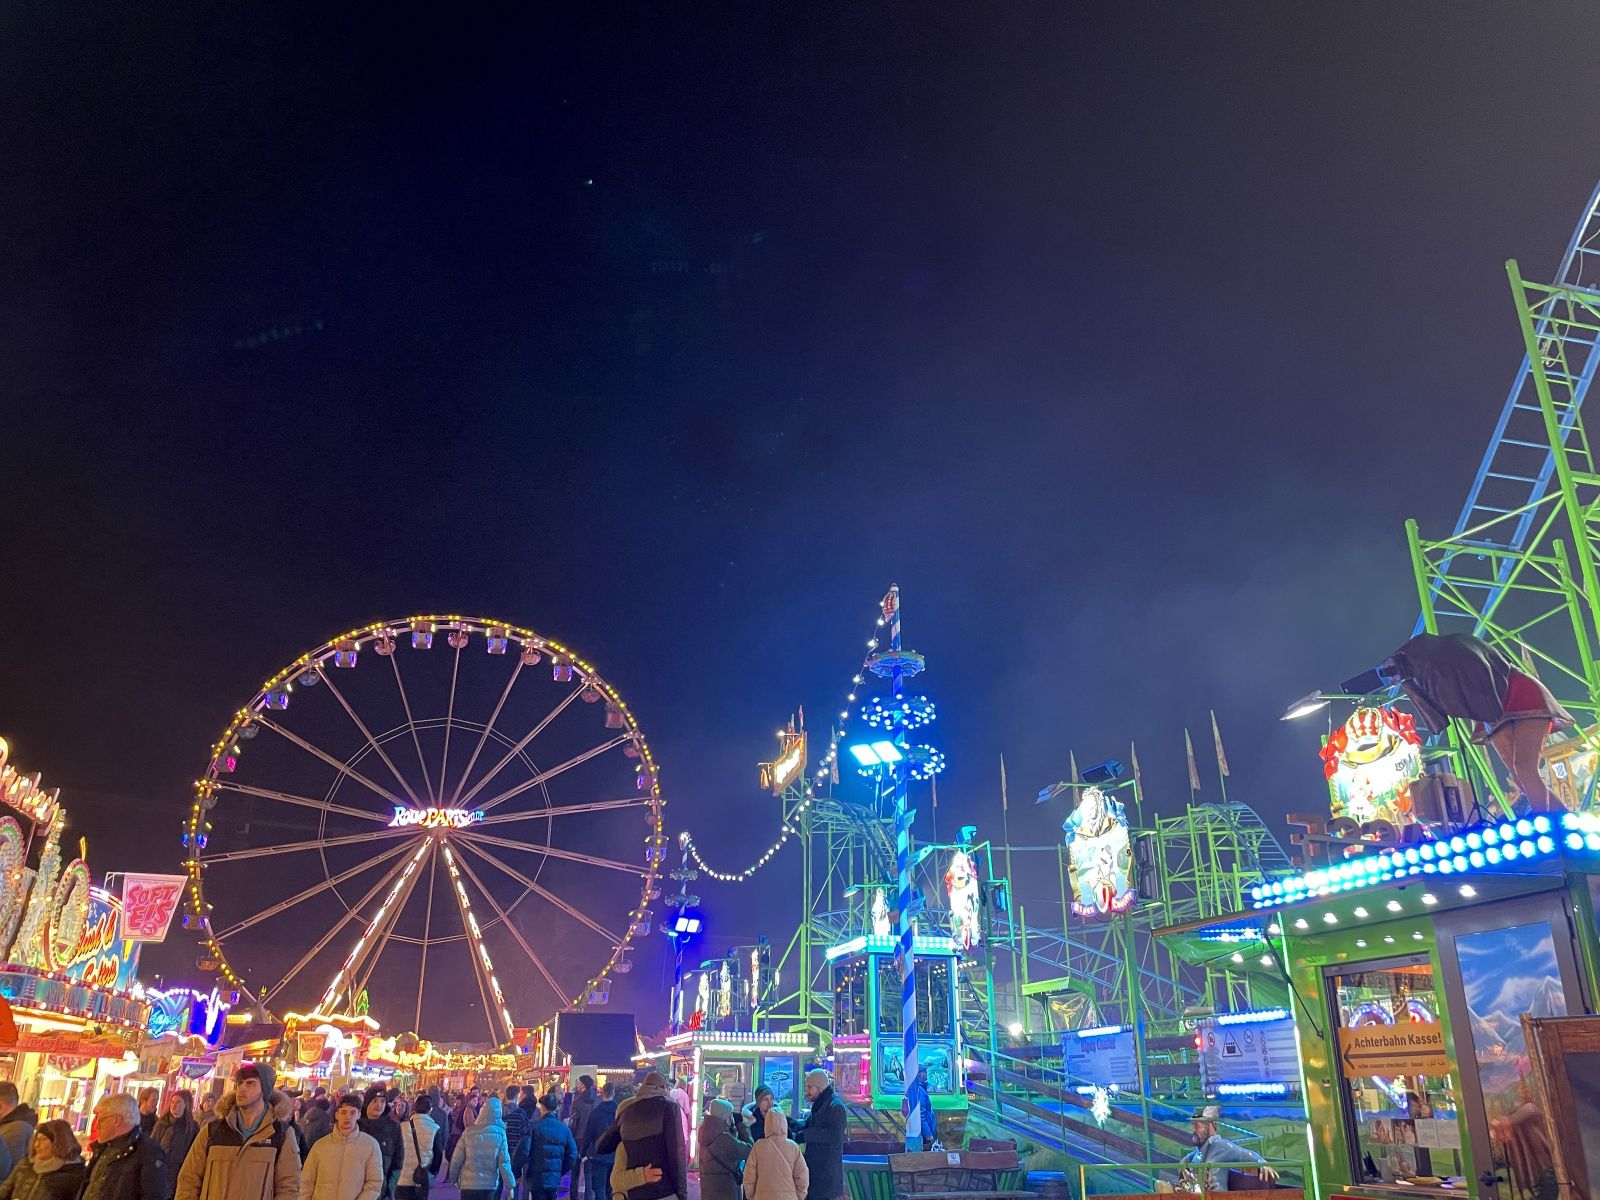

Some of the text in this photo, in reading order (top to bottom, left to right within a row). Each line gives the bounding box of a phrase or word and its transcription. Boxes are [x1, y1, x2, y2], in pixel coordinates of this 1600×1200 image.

[127, 884, 178, 912] SOFT
[128, 900, 174, 930] EIS
[1354, 1032, 1442, 1048] Achterbahn Kasse!
